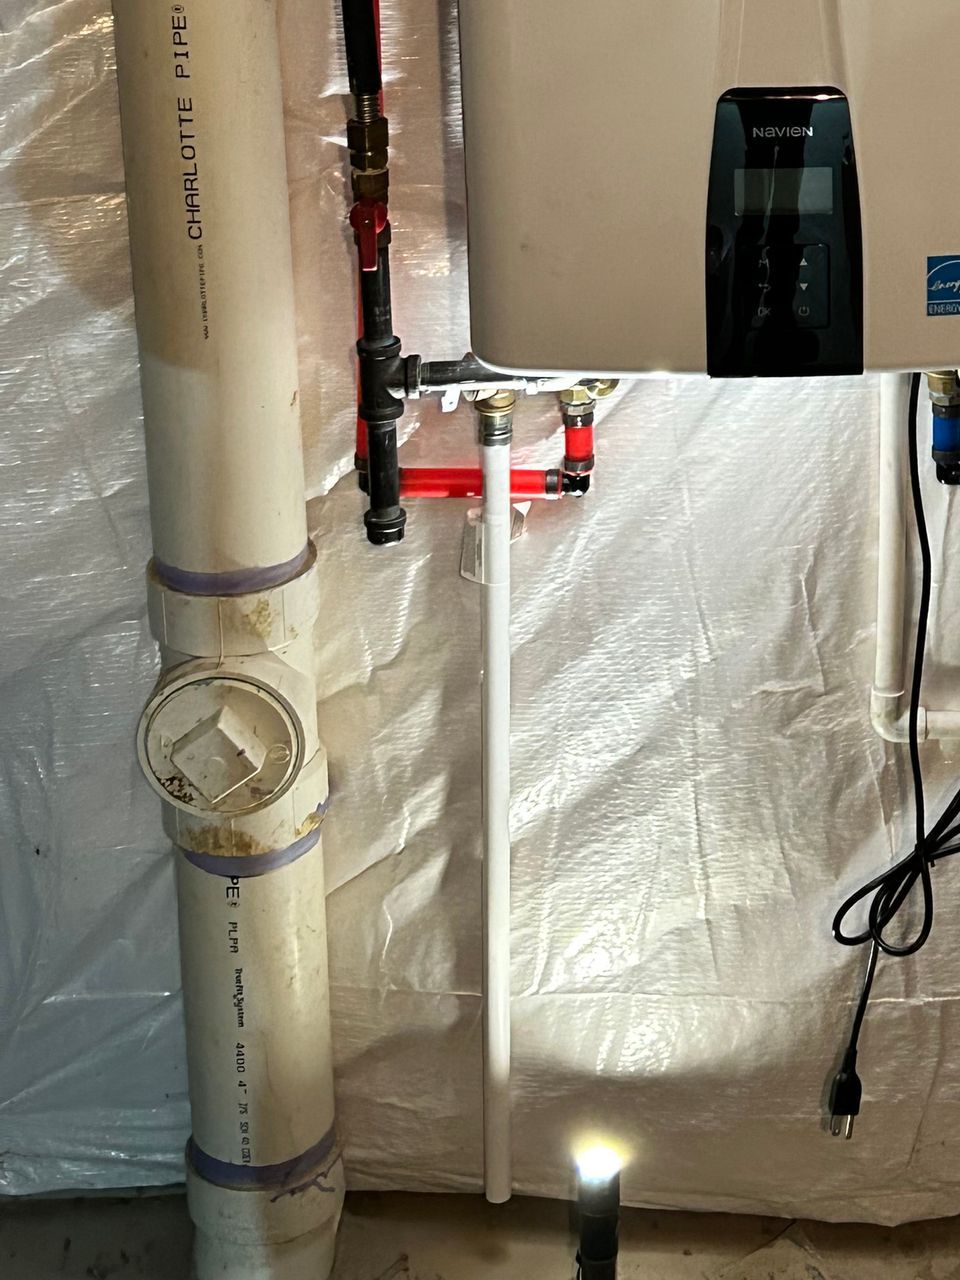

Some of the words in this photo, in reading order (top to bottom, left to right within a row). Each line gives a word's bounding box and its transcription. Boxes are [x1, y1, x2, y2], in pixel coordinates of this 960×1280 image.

[177, 97, 203, 239] CHARLOTTE
[228, 921, 239, 953] PLPA
[236, 1042, 246, 1073] 4400
